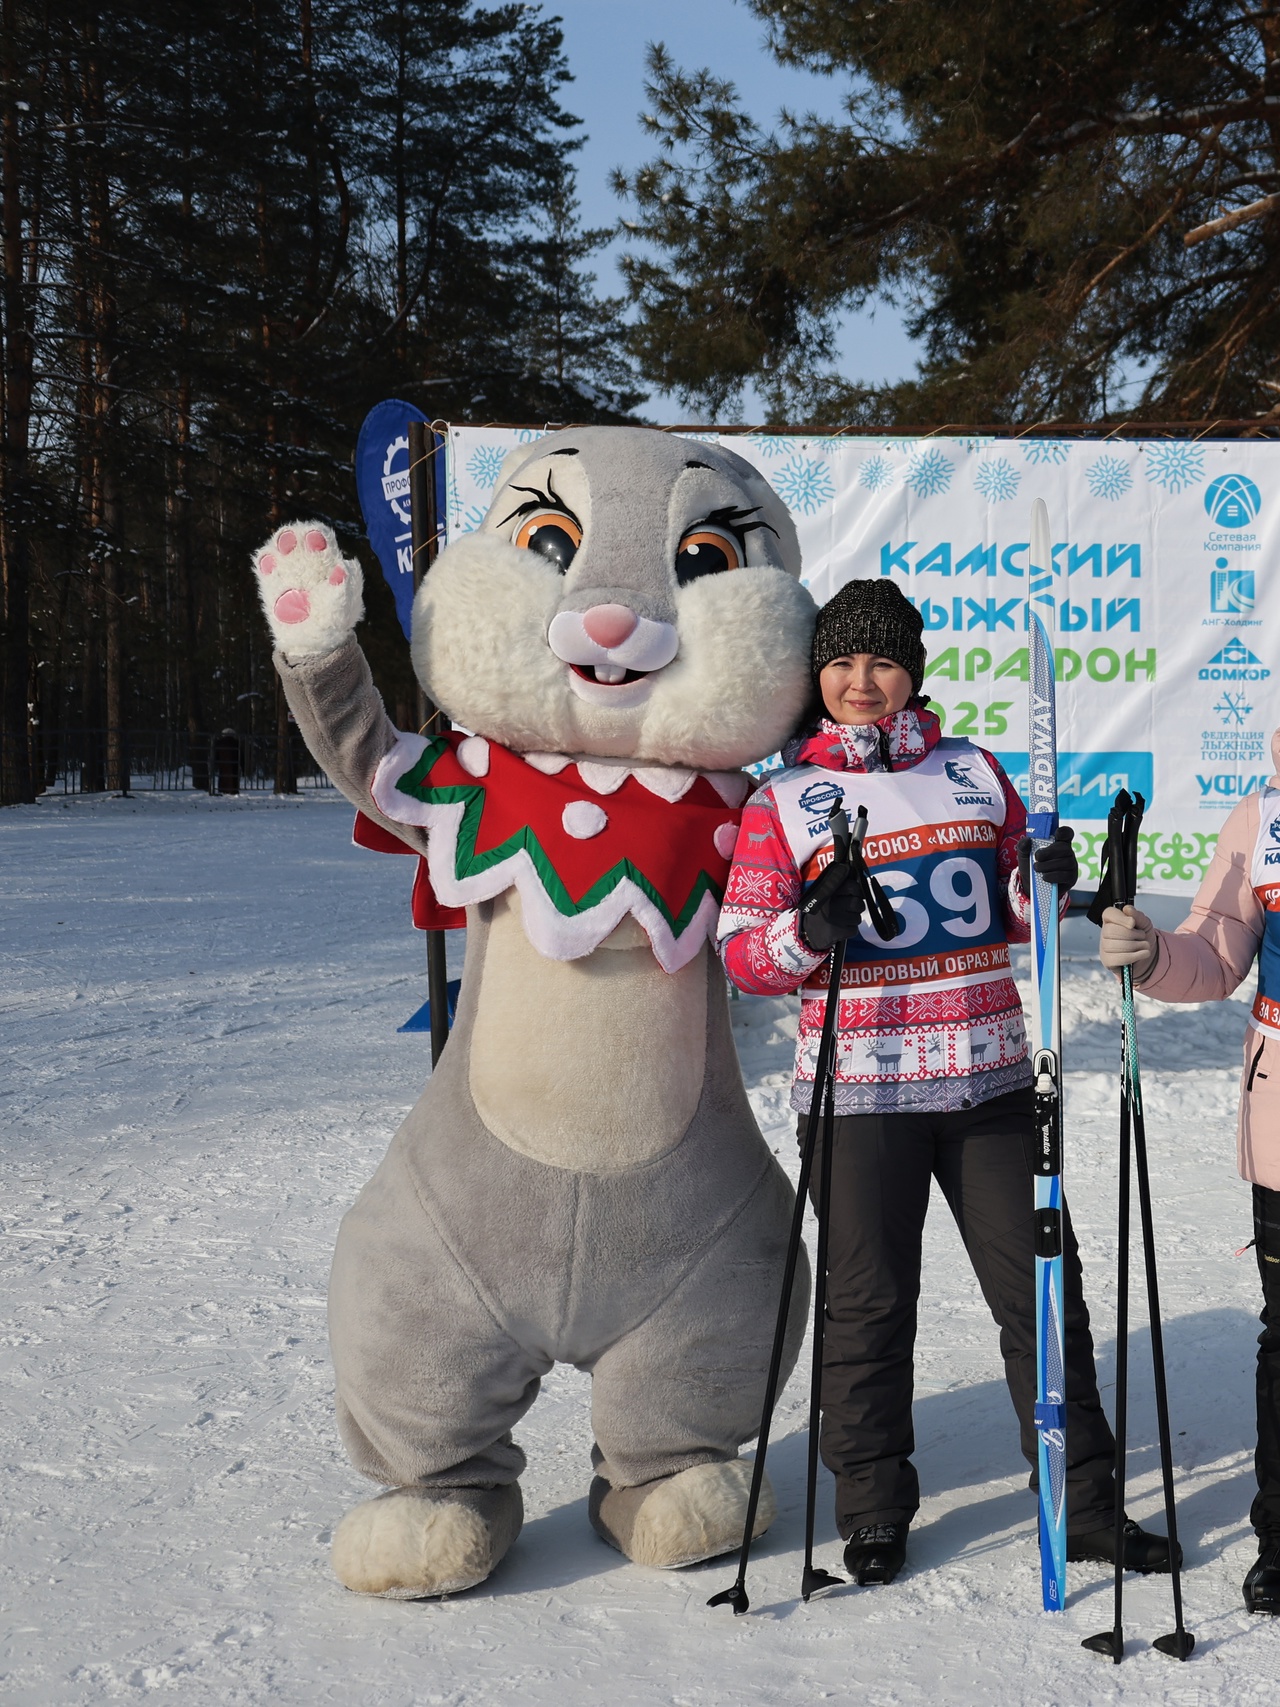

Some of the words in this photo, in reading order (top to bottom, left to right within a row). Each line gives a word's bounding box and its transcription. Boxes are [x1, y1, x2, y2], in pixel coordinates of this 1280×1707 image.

[1208, 532, 1257, 542] Сетевая
[1203, 542, 1262, 551] Компания
[907, 597, 1141, 632] ЫЖЫЙ
[1201, 618, 1263, 627] АНГ-Холдинг
[923, 647, 1157, 683] АРАФОН
[1198, 668, 1271, 681] ДОМКОР
[1200, 731, 1264, 741] ФЕДЕРАЦИЯ
[1200, 740, 1264, 750] ЛЫЖНЫХ
[1201, 751, 1246, 761] ГОНОК
[1248, 751, 1265, 761] РТ
[801, 789, 843, 806] ПРОФСОЮЗ
[954, 796, 995, 807] KAMAZ
[817, 833, 922, 872] ПРСОЮЗ
[858, 856, 992, 949] 69
[838, 956, 940, 984] ЗДОРОВЫЙ
[944, 951, 991, 974] ОБРАЗ
[1258, 1001, 1270, 1021] ЗА
